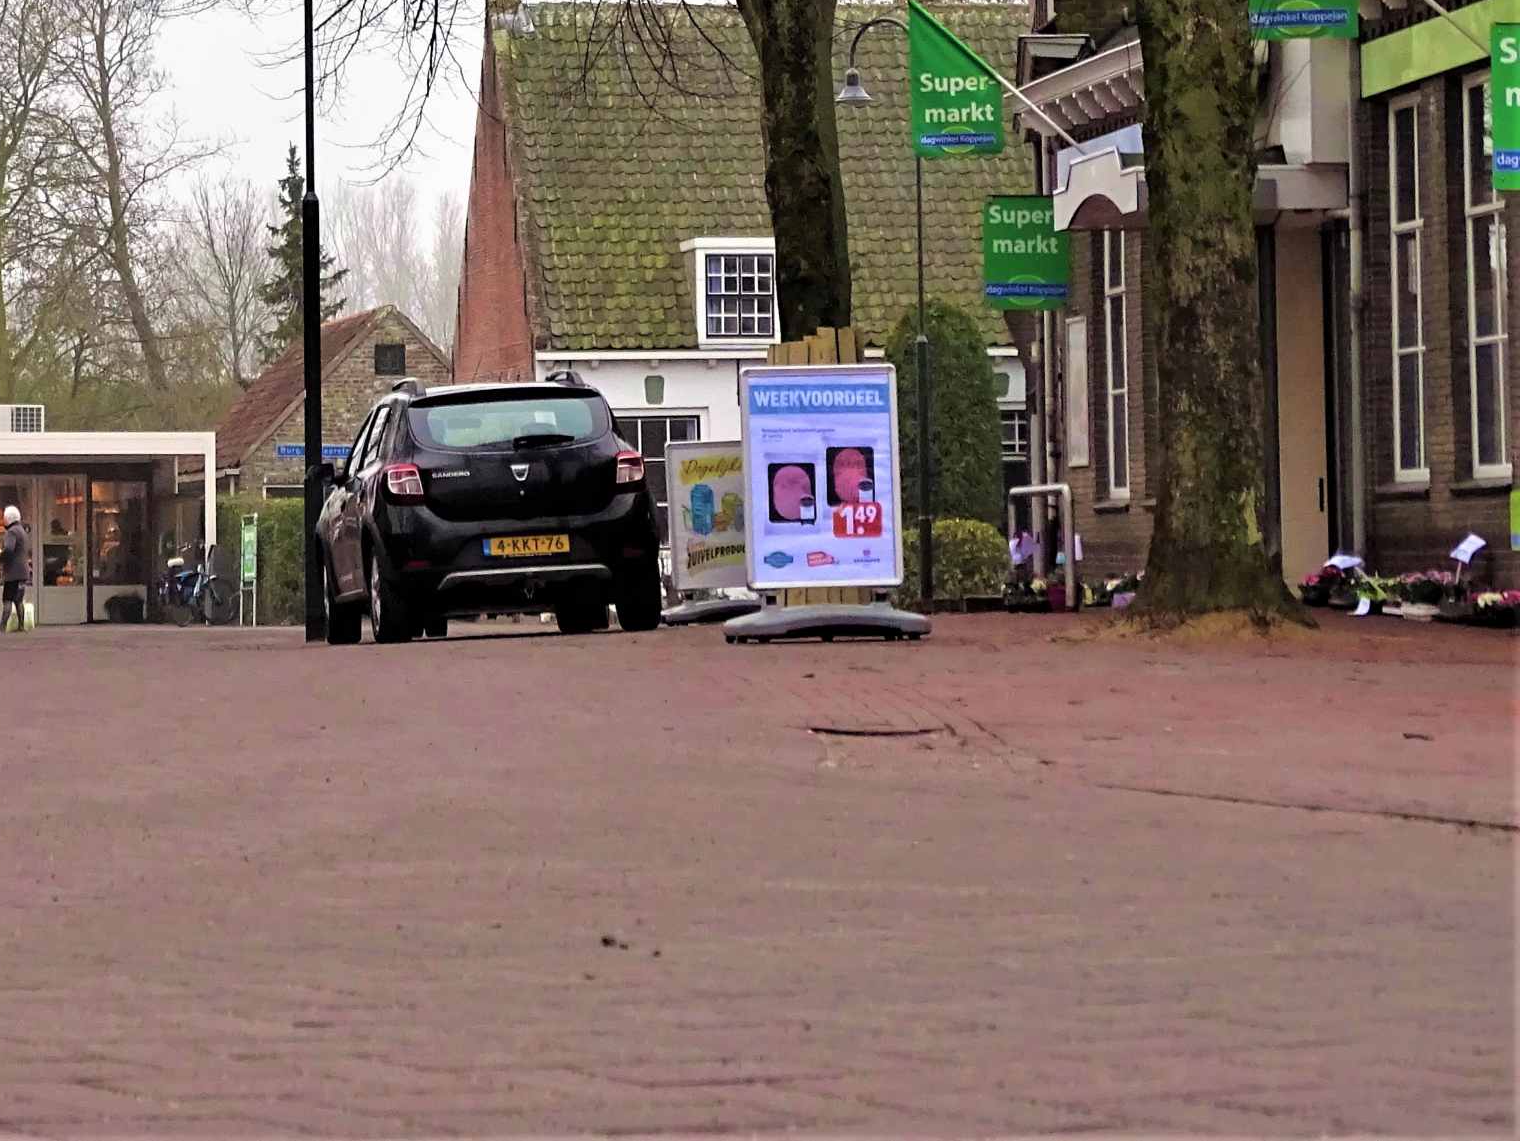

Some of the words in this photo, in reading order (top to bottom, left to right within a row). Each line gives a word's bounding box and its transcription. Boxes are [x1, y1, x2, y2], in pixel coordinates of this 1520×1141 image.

[924, 101, 995, 123] markt
[992, 234, 1059, 255] markt
[754, 389, 884, 407] WEEKVOORDEEL
[841, 504, 877, 536] 1.49
[497, 537, 565, 553] 4-KKT-76
